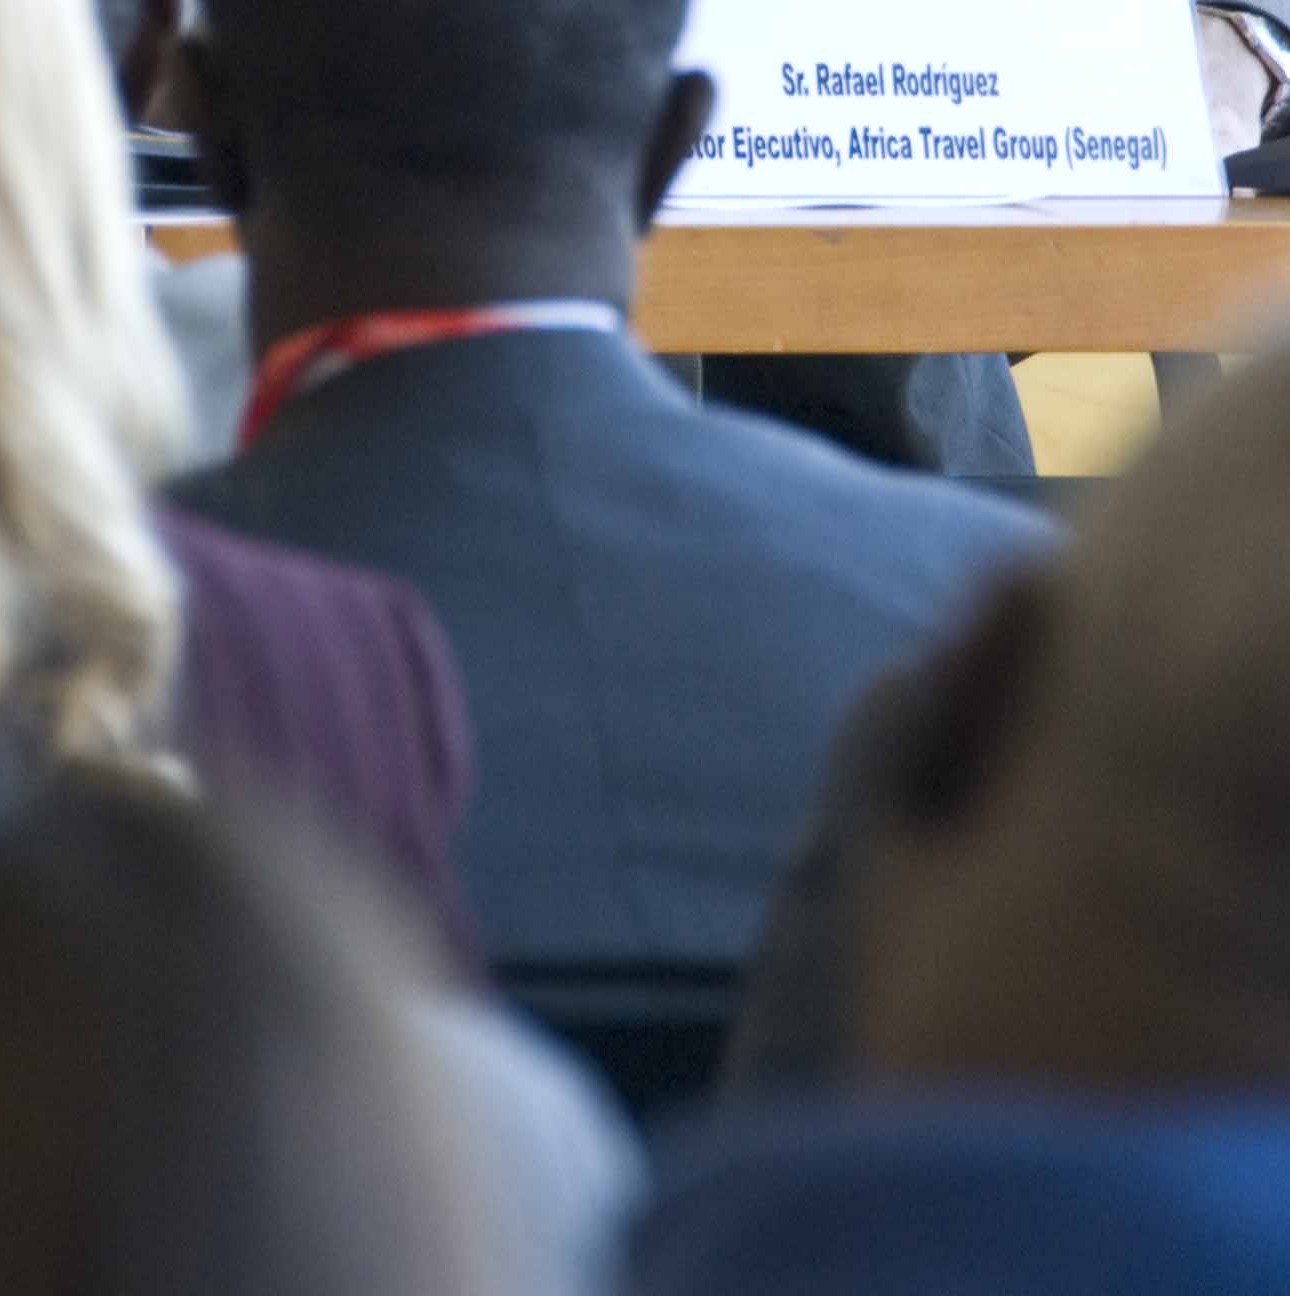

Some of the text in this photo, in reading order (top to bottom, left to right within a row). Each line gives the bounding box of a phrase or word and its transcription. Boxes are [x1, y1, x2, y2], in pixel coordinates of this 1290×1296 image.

[782, 62, 1000, 105] Sr. Rafael Rodríguez
[732, 126, 842, 168] Ejecutivo,
[848, 126, 913, 160] Africa
[918, 126, 986, 160] Travel
[993, 125, 1058, 169] Group
[1065, 125, 1168, 171] (Senegal)
